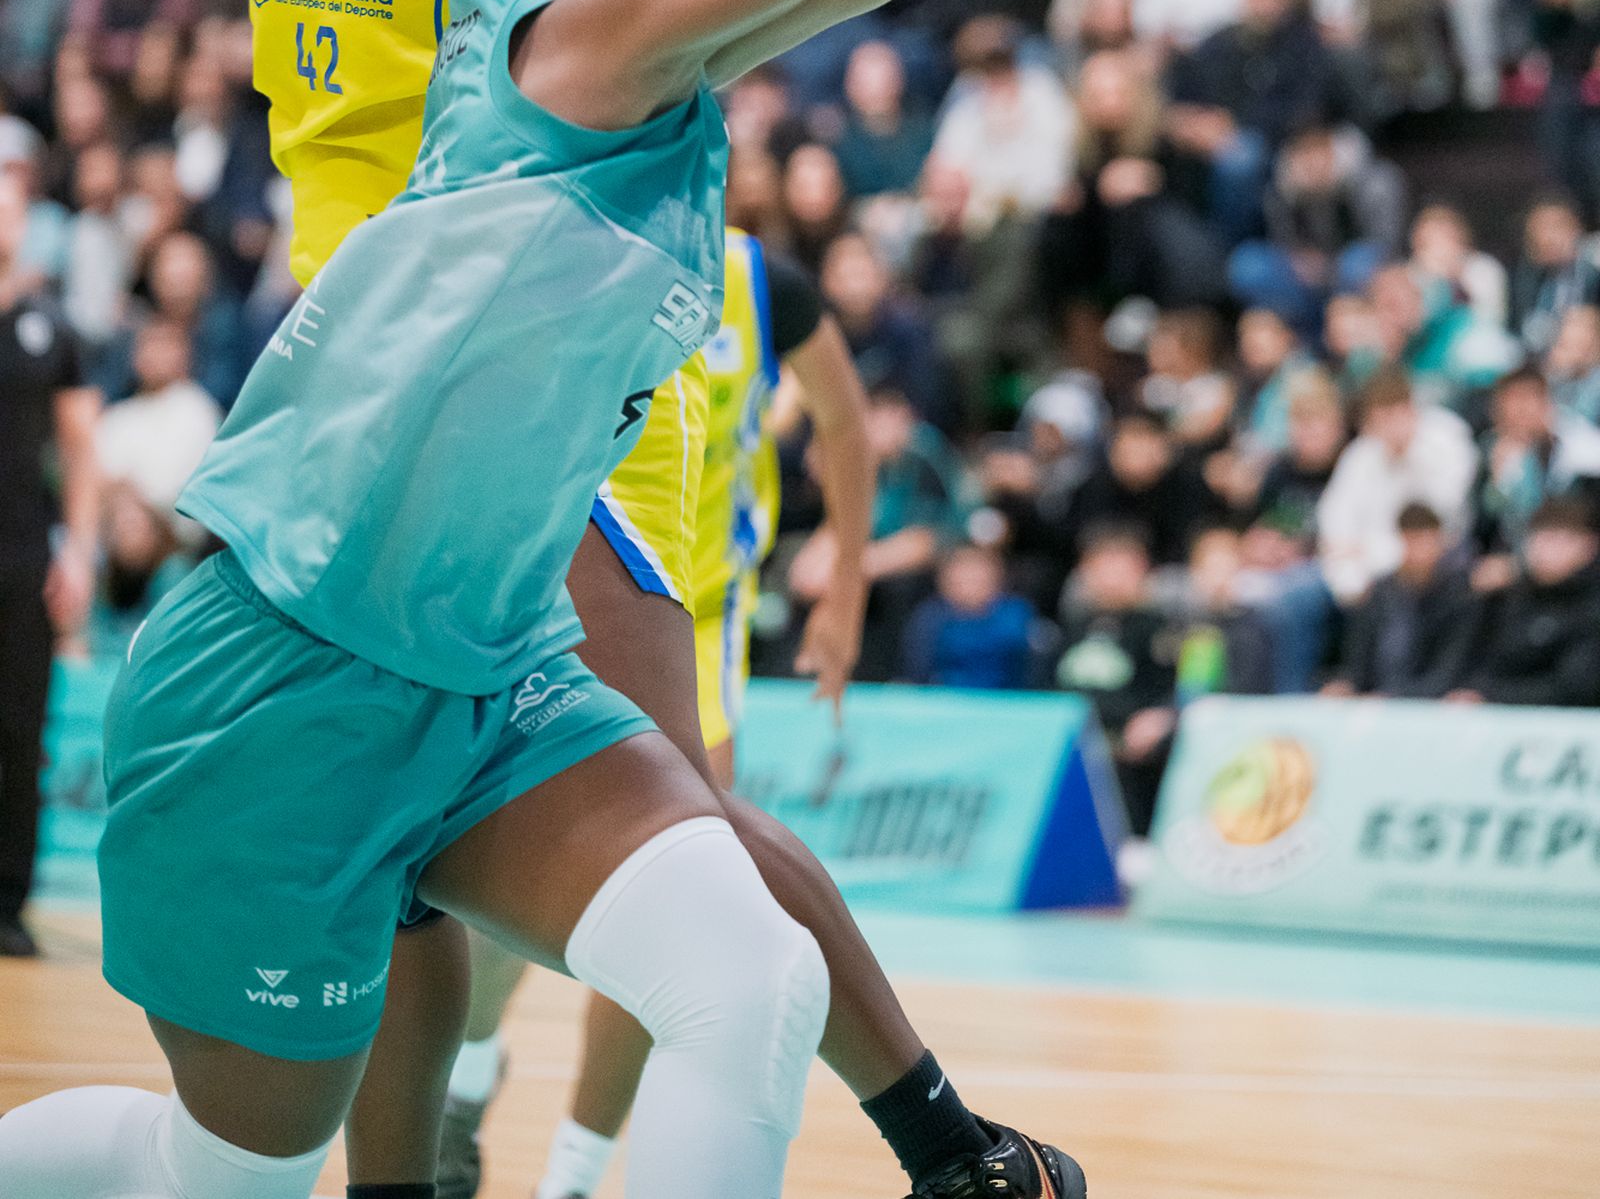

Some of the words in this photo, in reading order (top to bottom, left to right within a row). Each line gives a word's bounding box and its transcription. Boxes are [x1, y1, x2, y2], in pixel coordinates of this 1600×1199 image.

[328, 0, 343, 13] del
[345, 2, 394, 20] Deporte
[296, 22, 344, 95] 42
[1358, 804, 1600, 868] ESTEP
[245, 988, 299, 1009] vive
